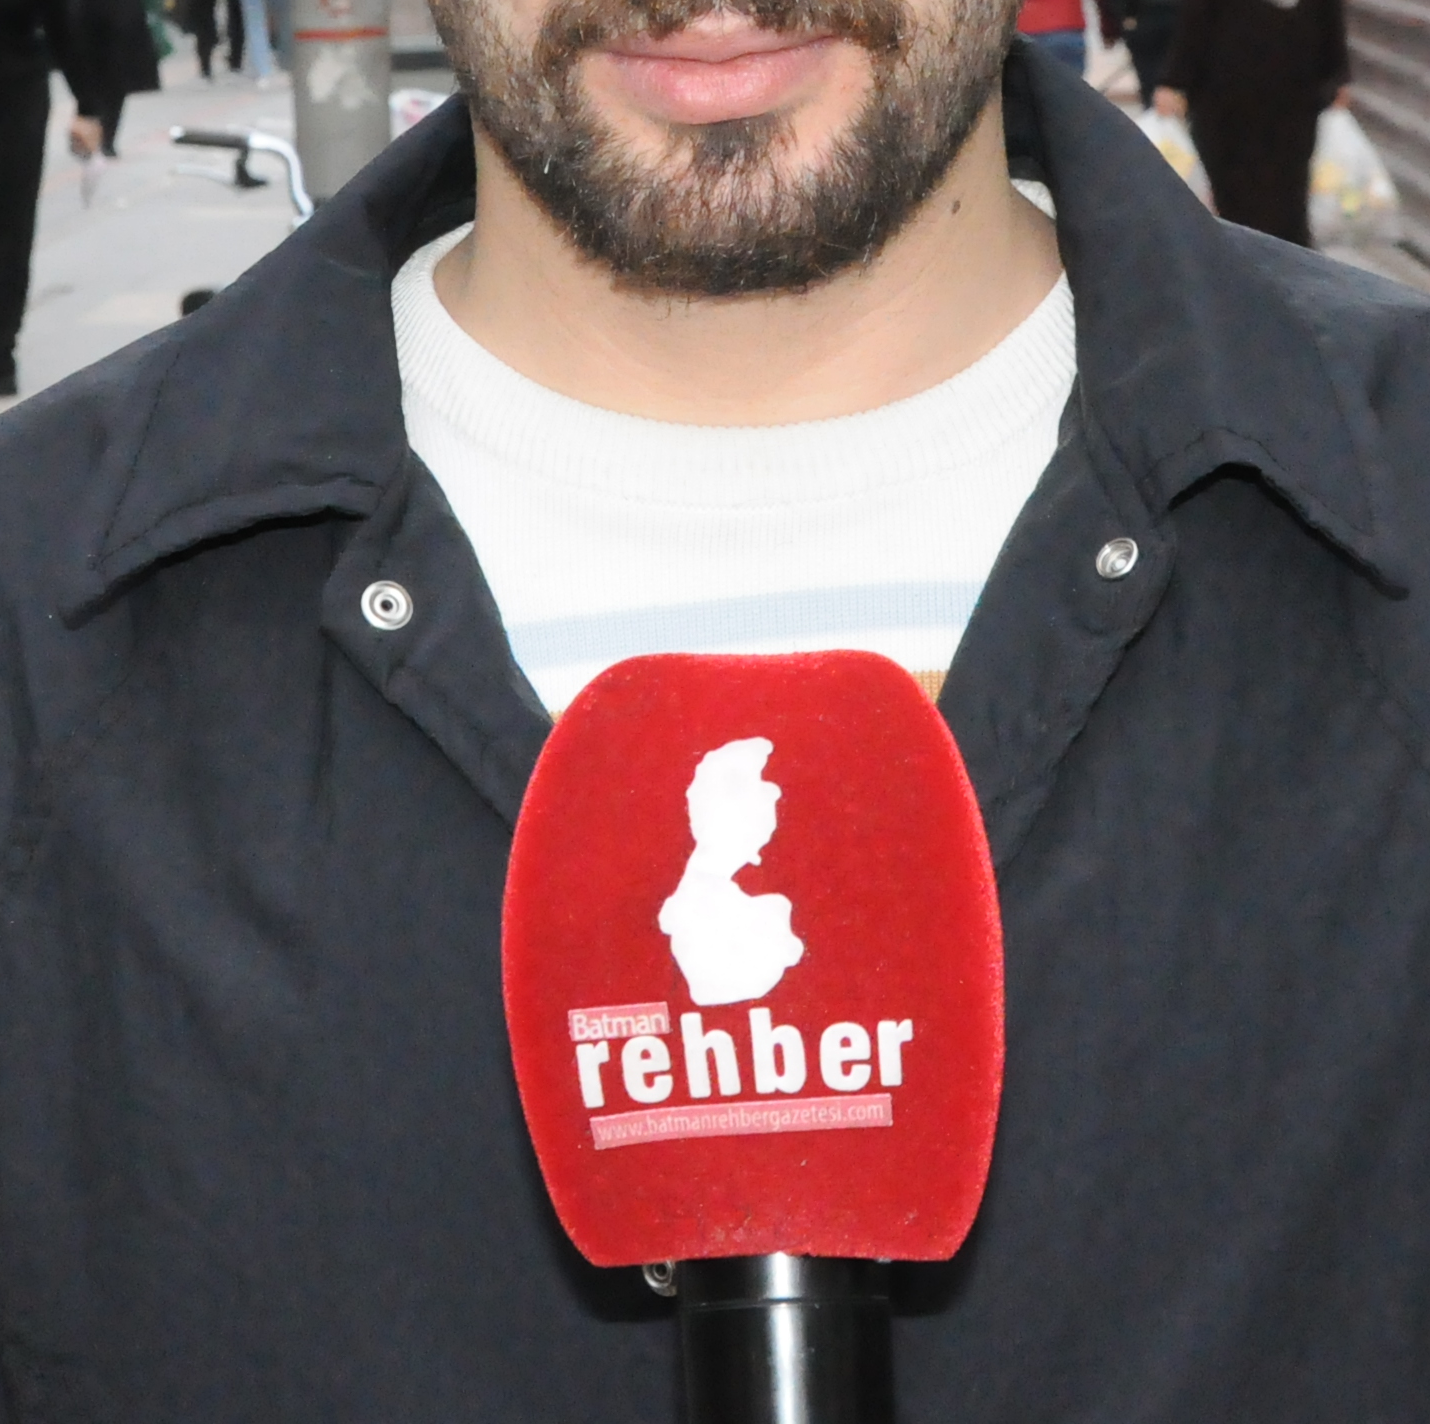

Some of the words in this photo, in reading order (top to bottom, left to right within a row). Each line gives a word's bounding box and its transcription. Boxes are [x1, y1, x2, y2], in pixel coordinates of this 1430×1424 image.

[572, 1012, 670, 1038] Batman
[575, 1007, 913, 1109] rehber
[597, 1100, 885, 1143] www.batmanrehbergazetesi.com
